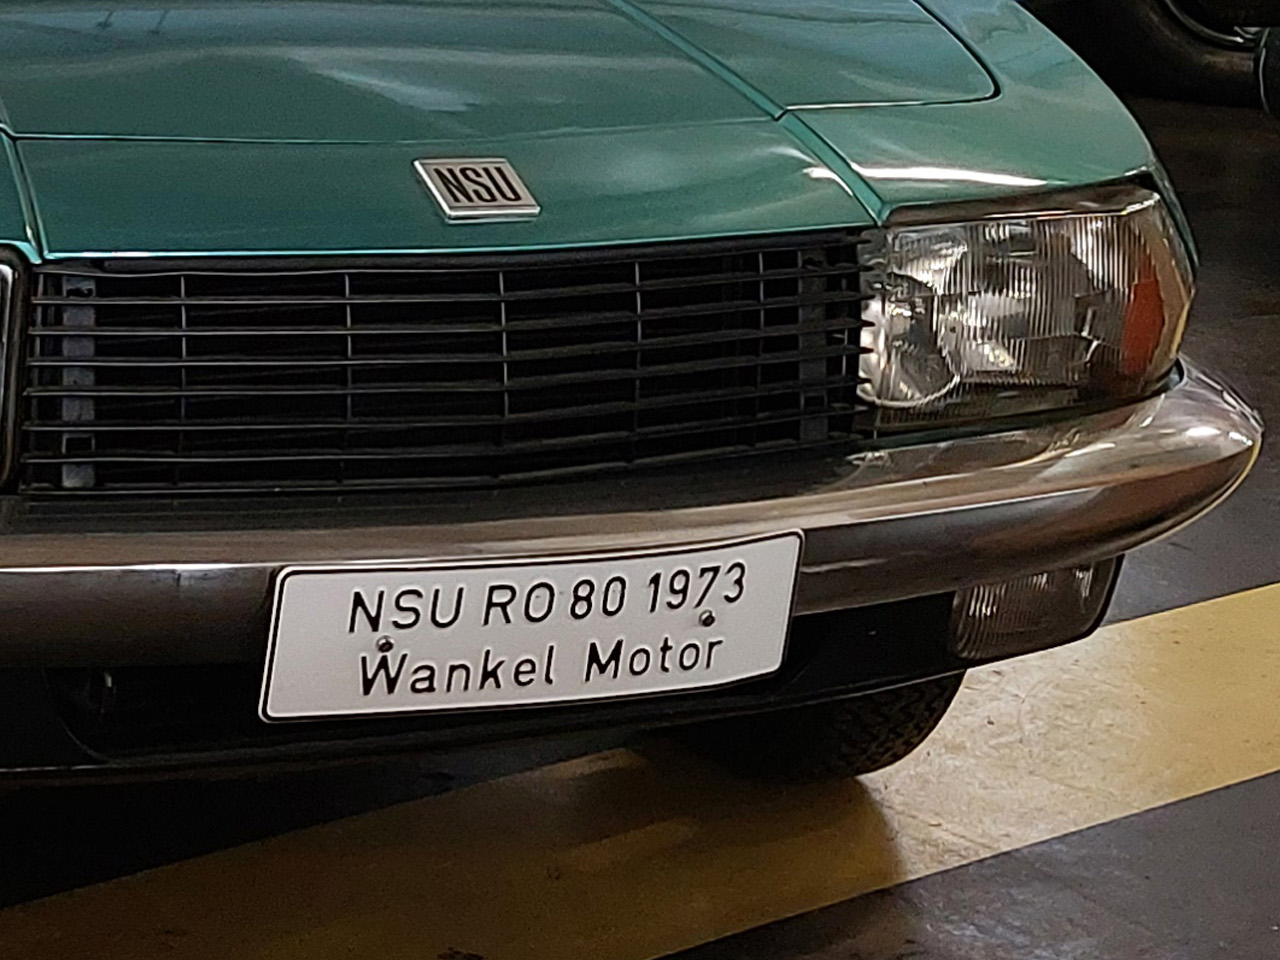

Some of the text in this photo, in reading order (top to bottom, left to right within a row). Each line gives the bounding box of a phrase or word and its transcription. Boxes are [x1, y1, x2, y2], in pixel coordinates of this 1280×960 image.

[433, 166, 522, 203] NSU
[348, 561, 747, 634] NSU RO 80 1973
[358, 637, 724, 697] Wankel Motor
